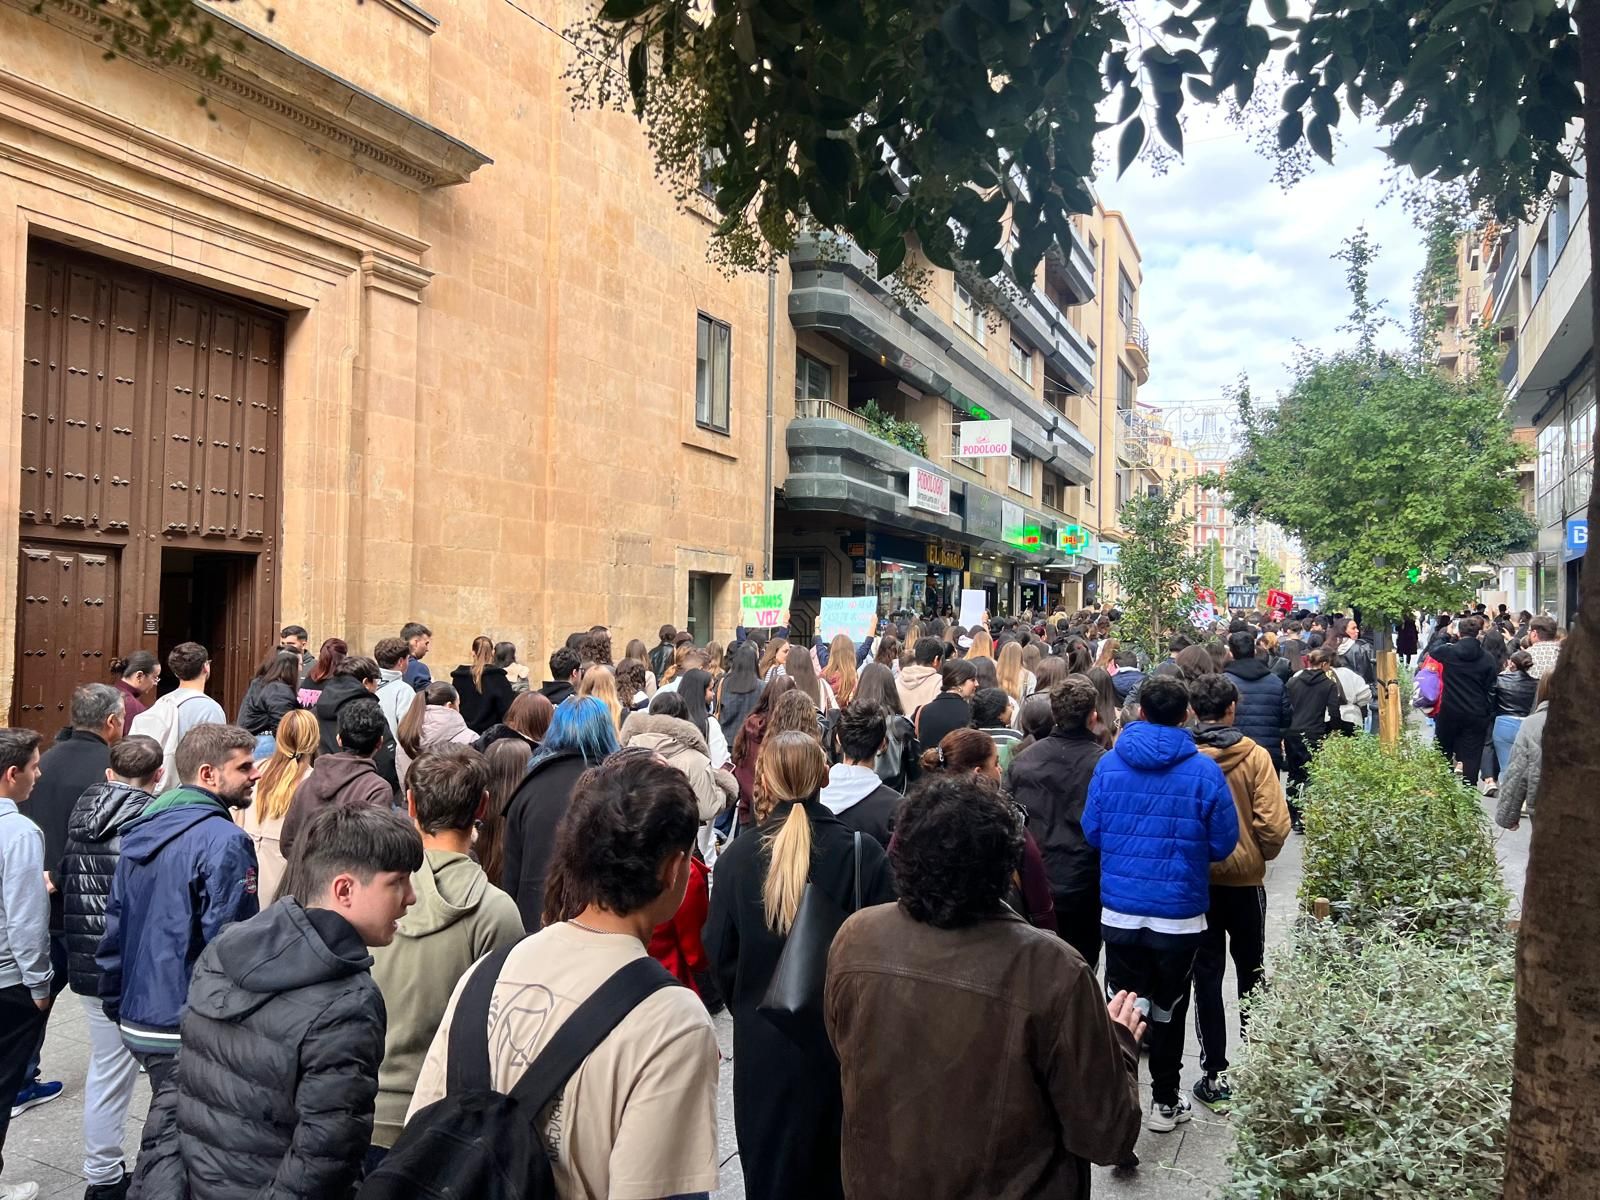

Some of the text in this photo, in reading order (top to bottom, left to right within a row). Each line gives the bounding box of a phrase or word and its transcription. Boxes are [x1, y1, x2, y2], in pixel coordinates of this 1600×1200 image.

[963, 443, 1008, 455] PODOLOGO
[917, 470, 944, 496] PODOLOGO
[742, 582, 764, 595] POR
[1229, 594, 1256, 608] MATA
[756, 610, 781, 626] VOZ
